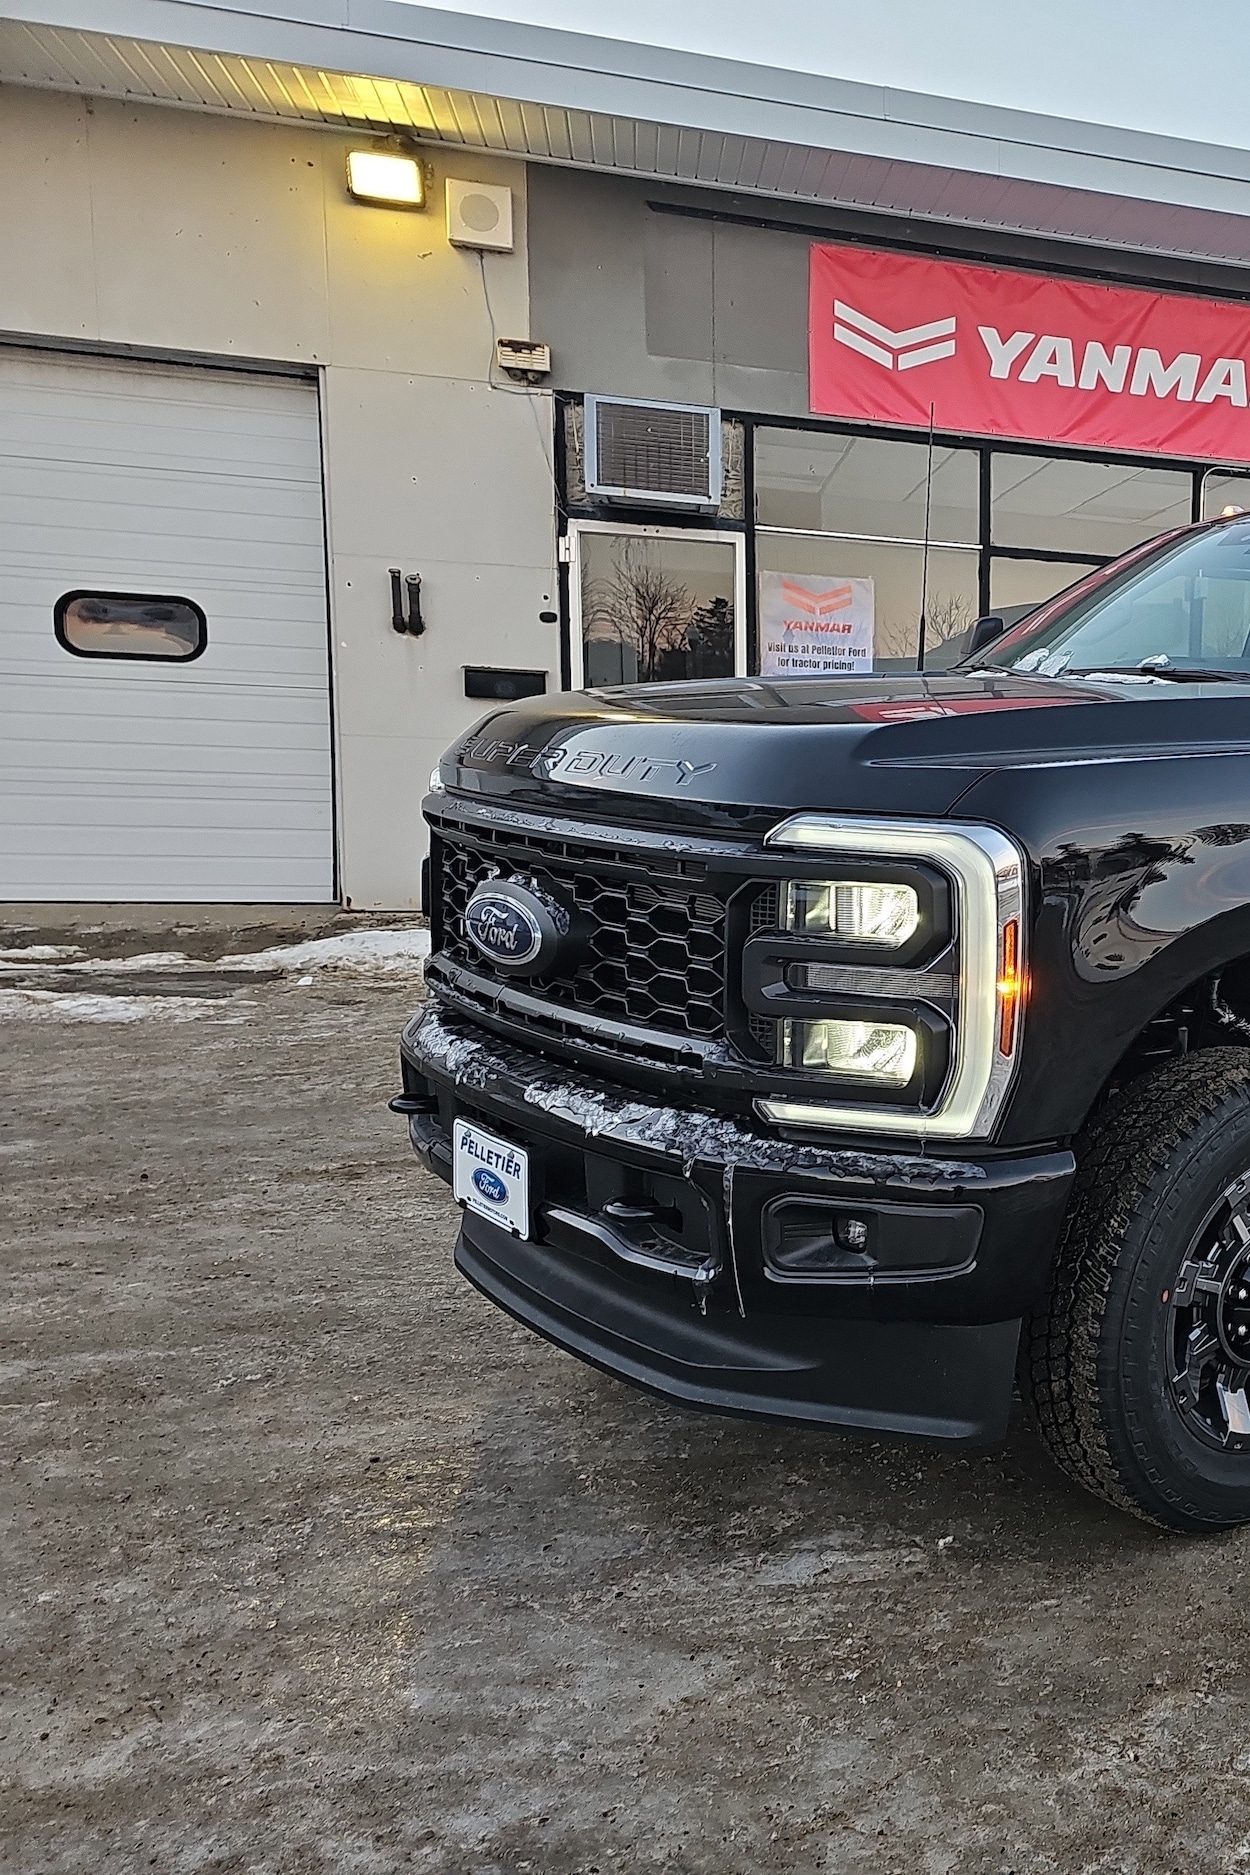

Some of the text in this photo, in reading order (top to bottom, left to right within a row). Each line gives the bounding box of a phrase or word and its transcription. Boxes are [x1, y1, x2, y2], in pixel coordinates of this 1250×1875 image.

[783, 620, 852, 634] YANMAR
[767, 642, 866, 658] Visit us at Pelletier Ford
[777, 657, 855, 671] for tractor pricing!
[456, 735, 717, 786] SUPER DUTY
[477, 905, 518, 951] Ford
[460, 1136, 521, 1180] PELLETIER
[478, 1172, 501, 1200] Ford
